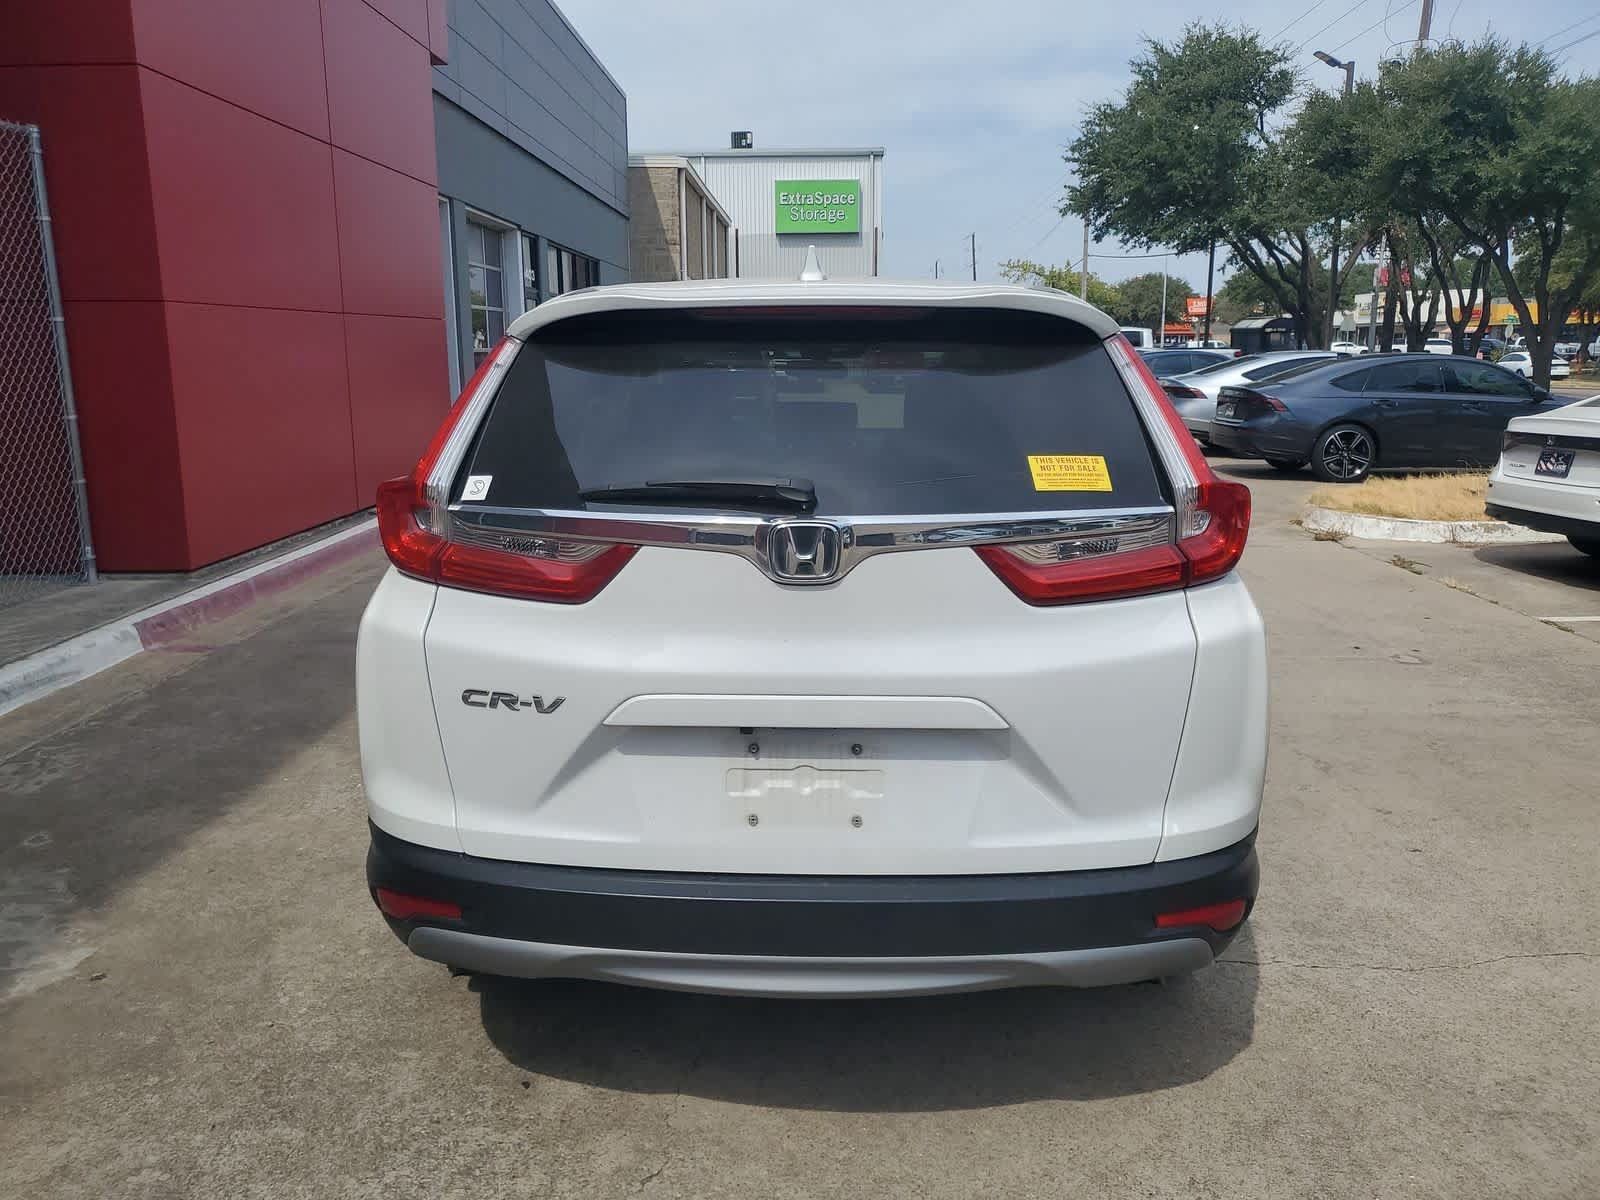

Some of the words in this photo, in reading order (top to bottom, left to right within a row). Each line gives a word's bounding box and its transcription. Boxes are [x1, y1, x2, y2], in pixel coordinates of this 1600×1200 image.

[779, 191, 855, 208] ExtraSpace
[790, 206, 846, 223] Storage
[1039, 464, 1057, 472] NOT
[1059, 464, 1075, 472] FOR
[1077, 464, 1097, 472] SALE
[1055, 457, 1089, 465] VEHICLE
[1091, 457, 1100, 465] IS
[461, 689, 568, 714] CR-V
